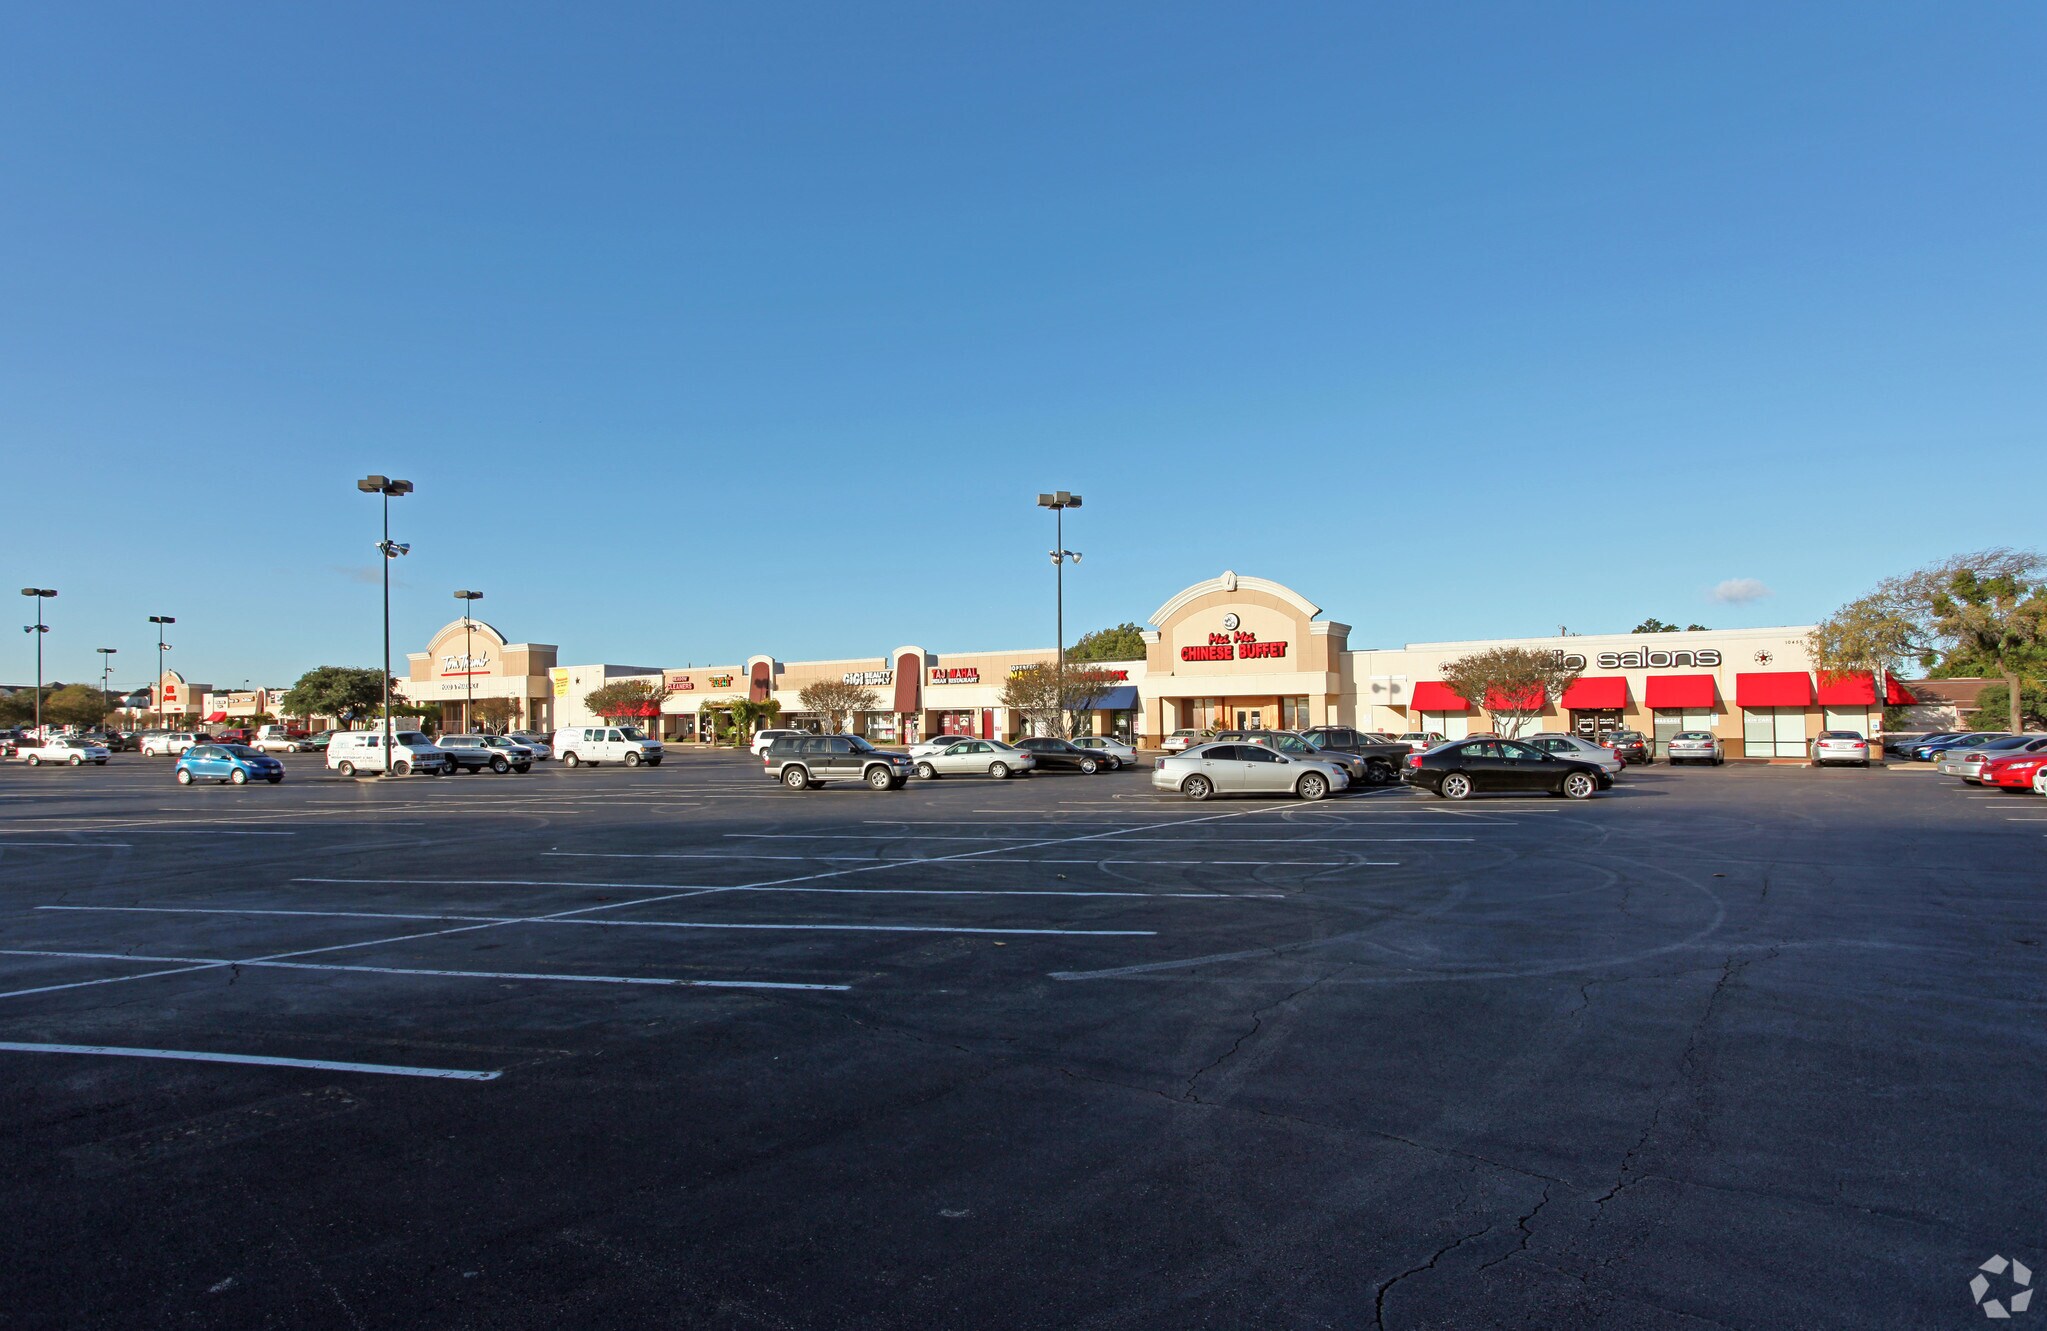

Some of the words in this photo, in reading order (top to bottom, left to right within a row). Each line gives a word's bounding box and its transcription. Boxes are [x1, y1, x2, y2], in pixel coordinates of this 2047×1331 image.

[1208, 632, 1231, 645] Mei
[1233, 631, 1257, 644] Mei
[1181, 645, 1234, 661] CHINESE
[1239, 641, 1288, 659] BUFFET
[1597, 645, 1722, 669] salons
[441, 655, 460, 672] Tom
[932, 669, 946, 678] TAJ
[949, 668, 979, 678] MAHAL
